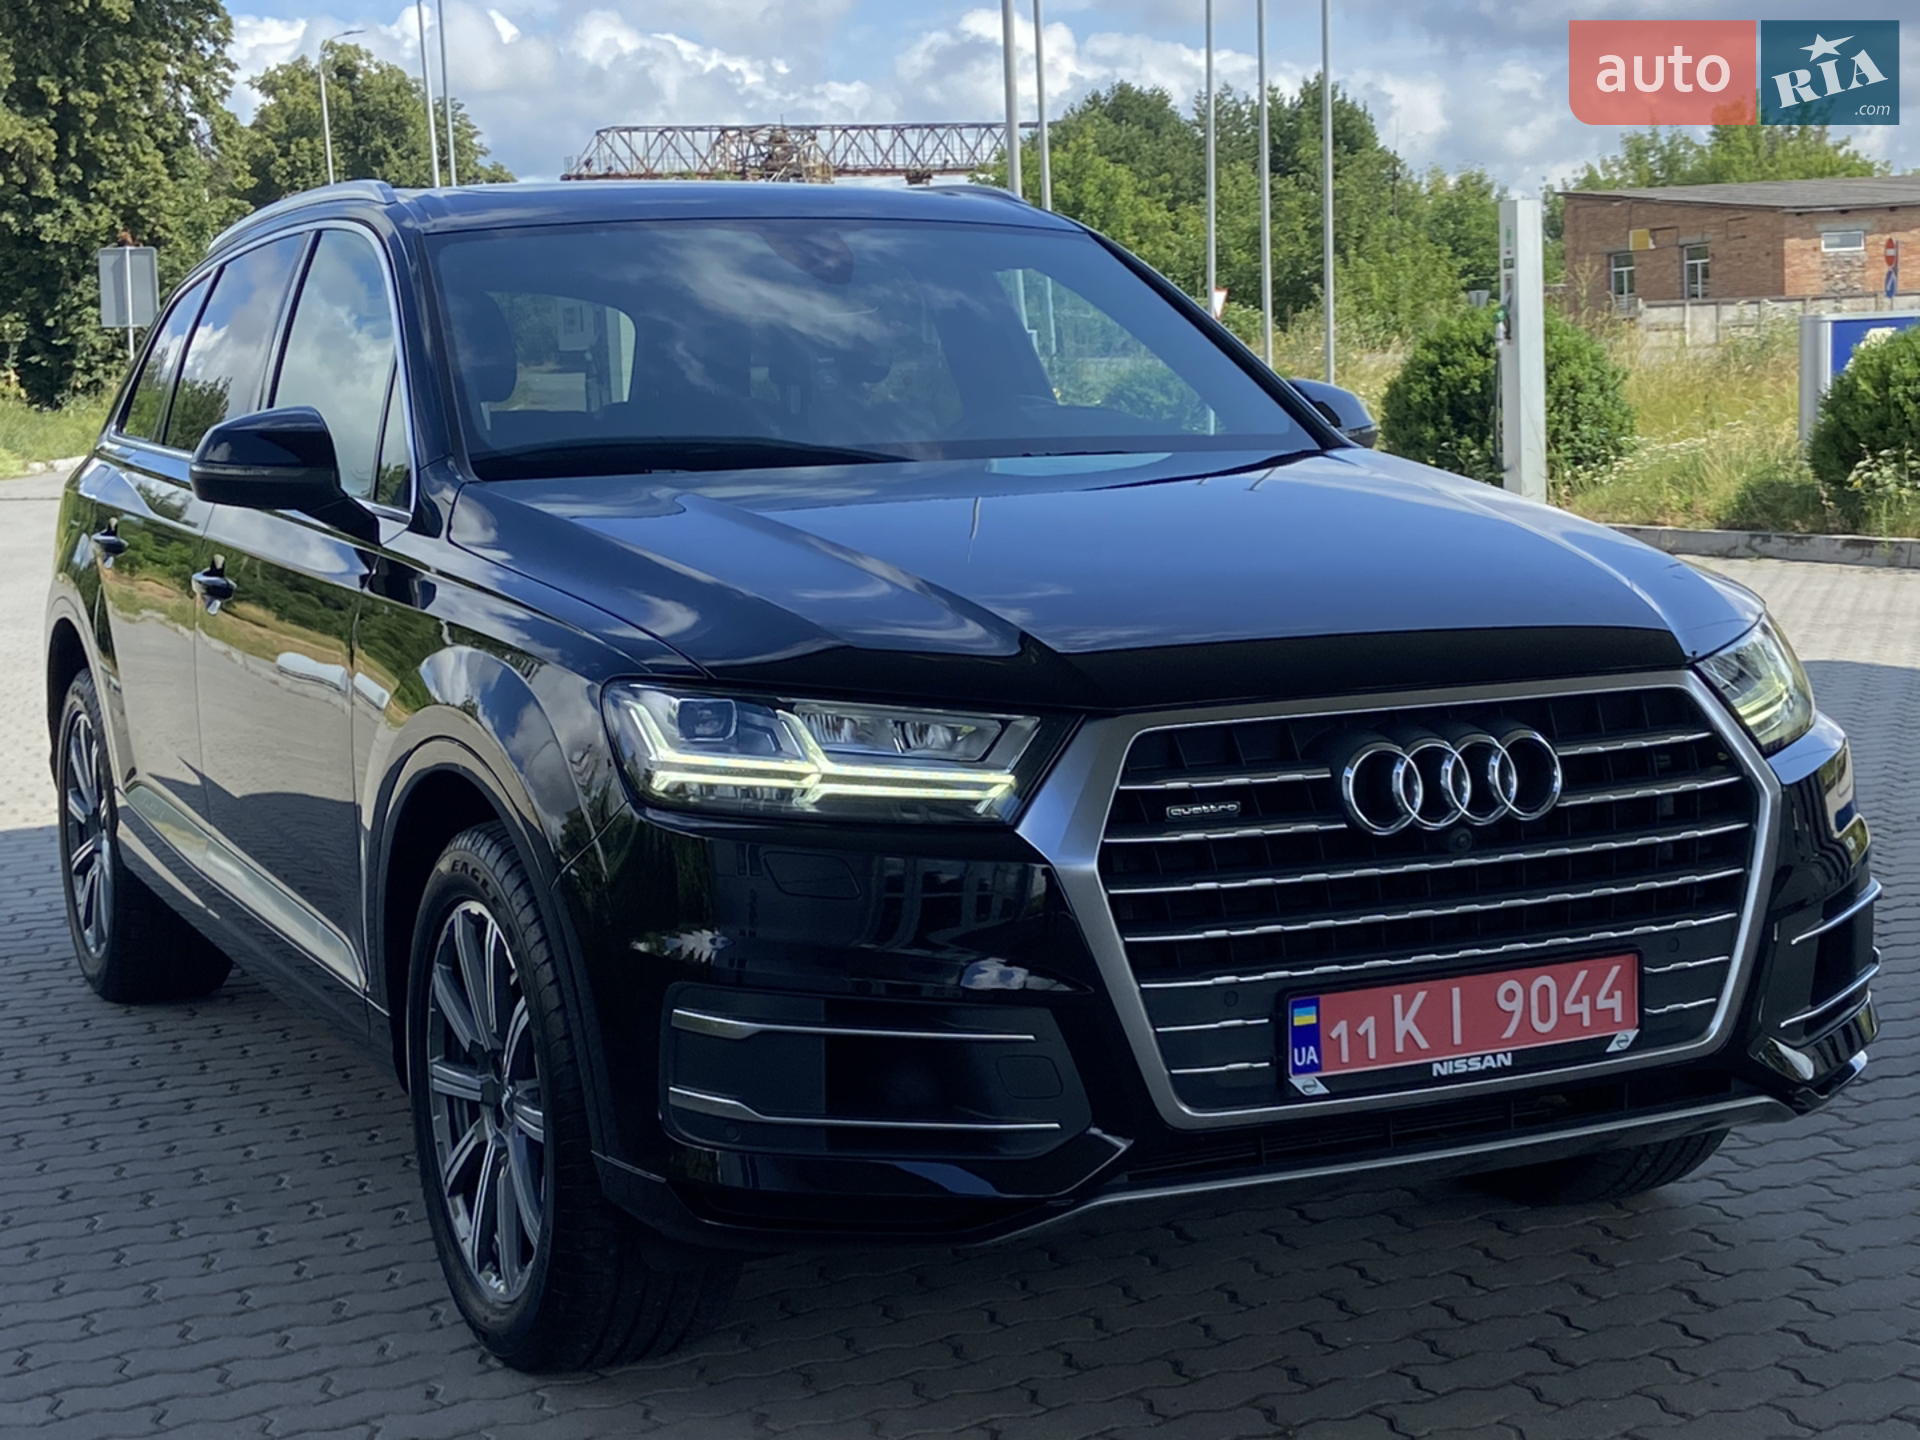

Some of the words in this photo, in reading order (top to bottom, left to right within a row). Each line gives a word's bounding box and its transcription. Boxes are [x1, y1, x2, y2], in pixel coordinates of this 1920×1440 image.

[1170, 803, 1238, 816] quattro
[1496, 964, 1622, 1040] 9044
[1293, 1045, 1319, 1067] UA
[1431, 1051, 1513, 1077] NISSAN
